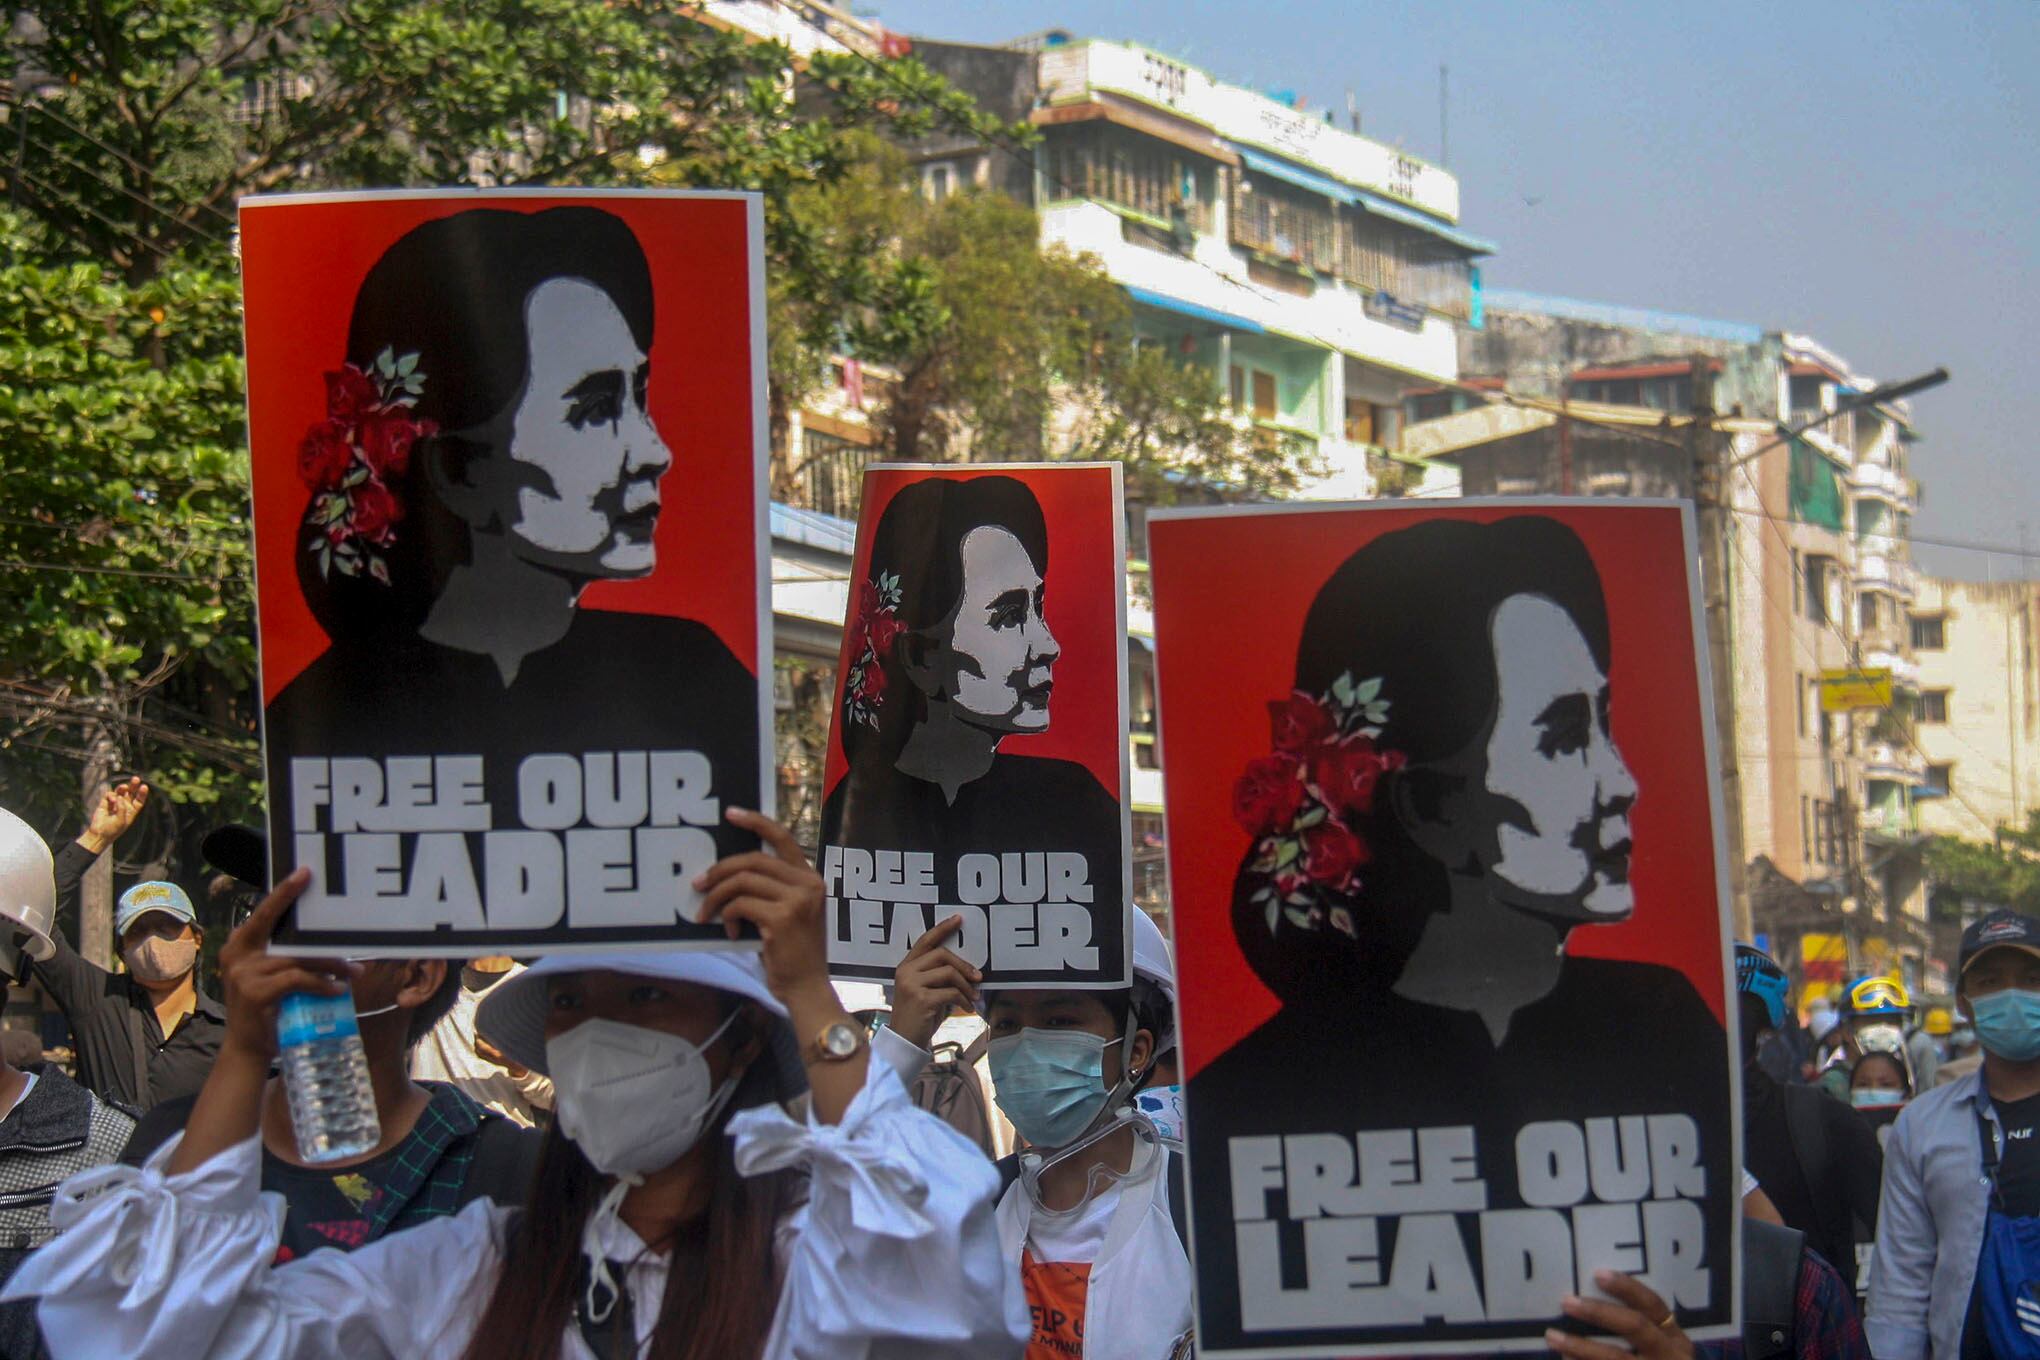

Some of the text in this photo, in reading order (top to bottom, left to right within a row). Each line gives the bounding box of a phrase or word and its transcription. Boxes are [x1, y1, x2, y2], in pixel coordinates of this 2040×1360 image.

[291, 749, 720, 833] FREE OUR
[294, 826, 725, 932] LEADER
[823, 845, 1094, 904] FREE OUR
[826, 896, 1100, 971] LEADER
[1228, 1113, 1706, 1221] FREE OUR
[1235, 1200, 1711, 1332] LEADER
[1029, 1305, 1067, 1333] ELP
